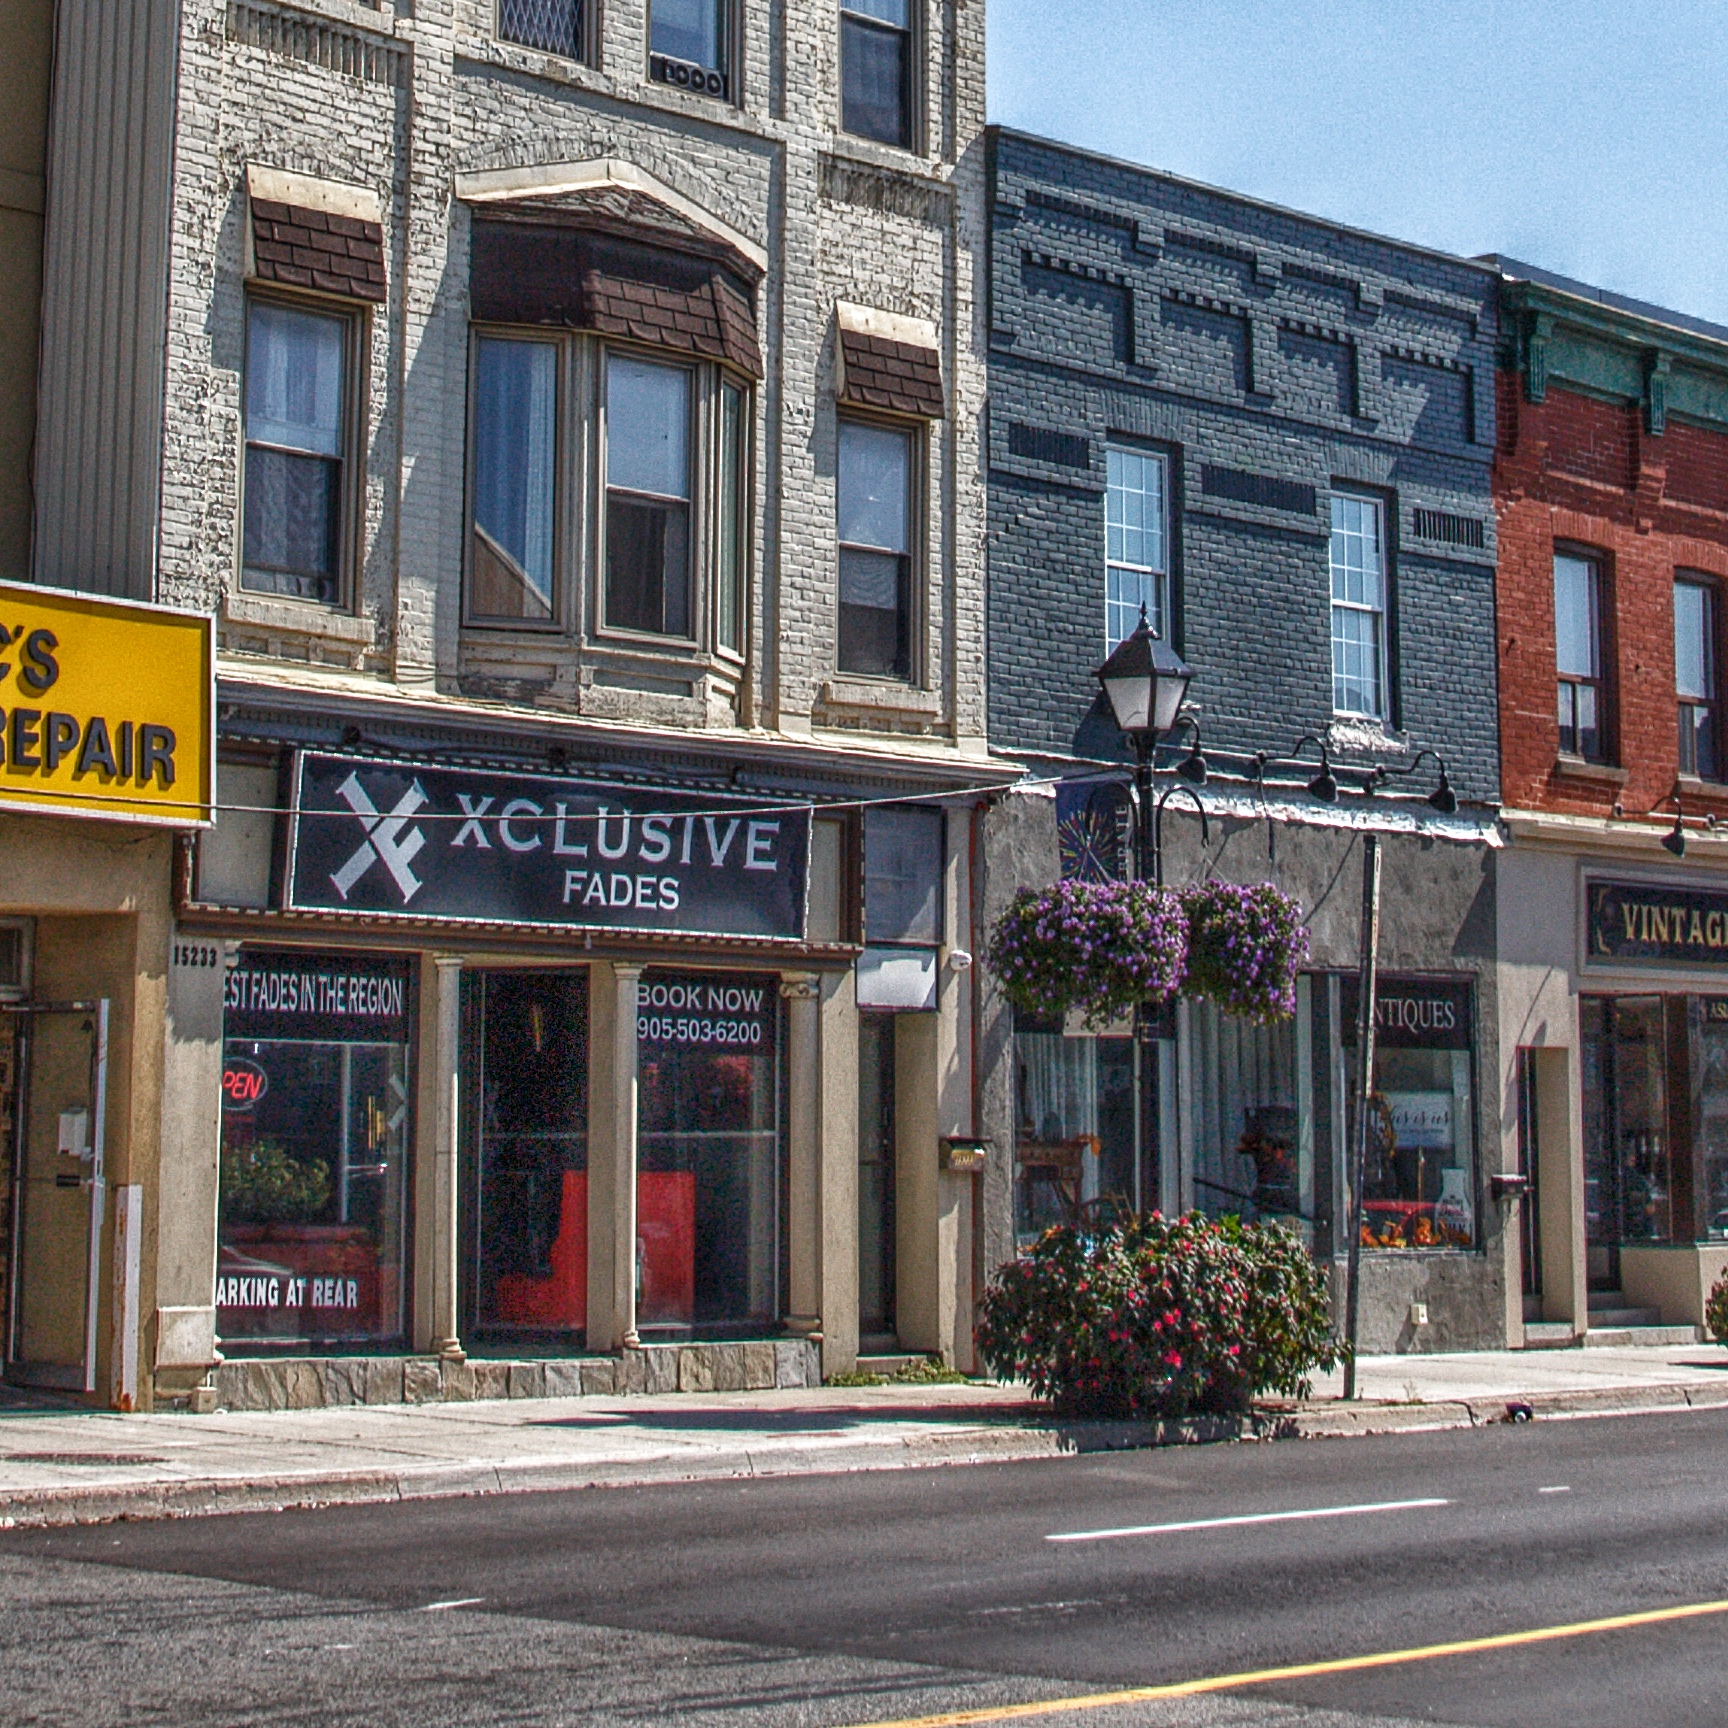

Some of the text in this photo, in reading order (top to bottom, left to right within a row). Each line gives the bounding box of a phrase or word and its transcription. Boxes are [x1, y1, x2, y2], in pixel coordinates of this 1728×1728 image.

[0, 706, 176, 784] EPAIR
[451, 793, 780, 871] XCLUSIVE
[562, 869, 680, 910] FADES
[173, 944, 218, 968] 15233
[223, 970, 402, 1016] EST FADES IN THE REGION
[637, 984, 763, 1012] BOOK NOW
[637, 1016, 761, 1044] 905-503-6200
[1374, 998, 1455, 1034] NTIQUES
[223, 1071, 262, 1100] PEN
[216, 1277, 358, 1308] ARKING AT REAR
